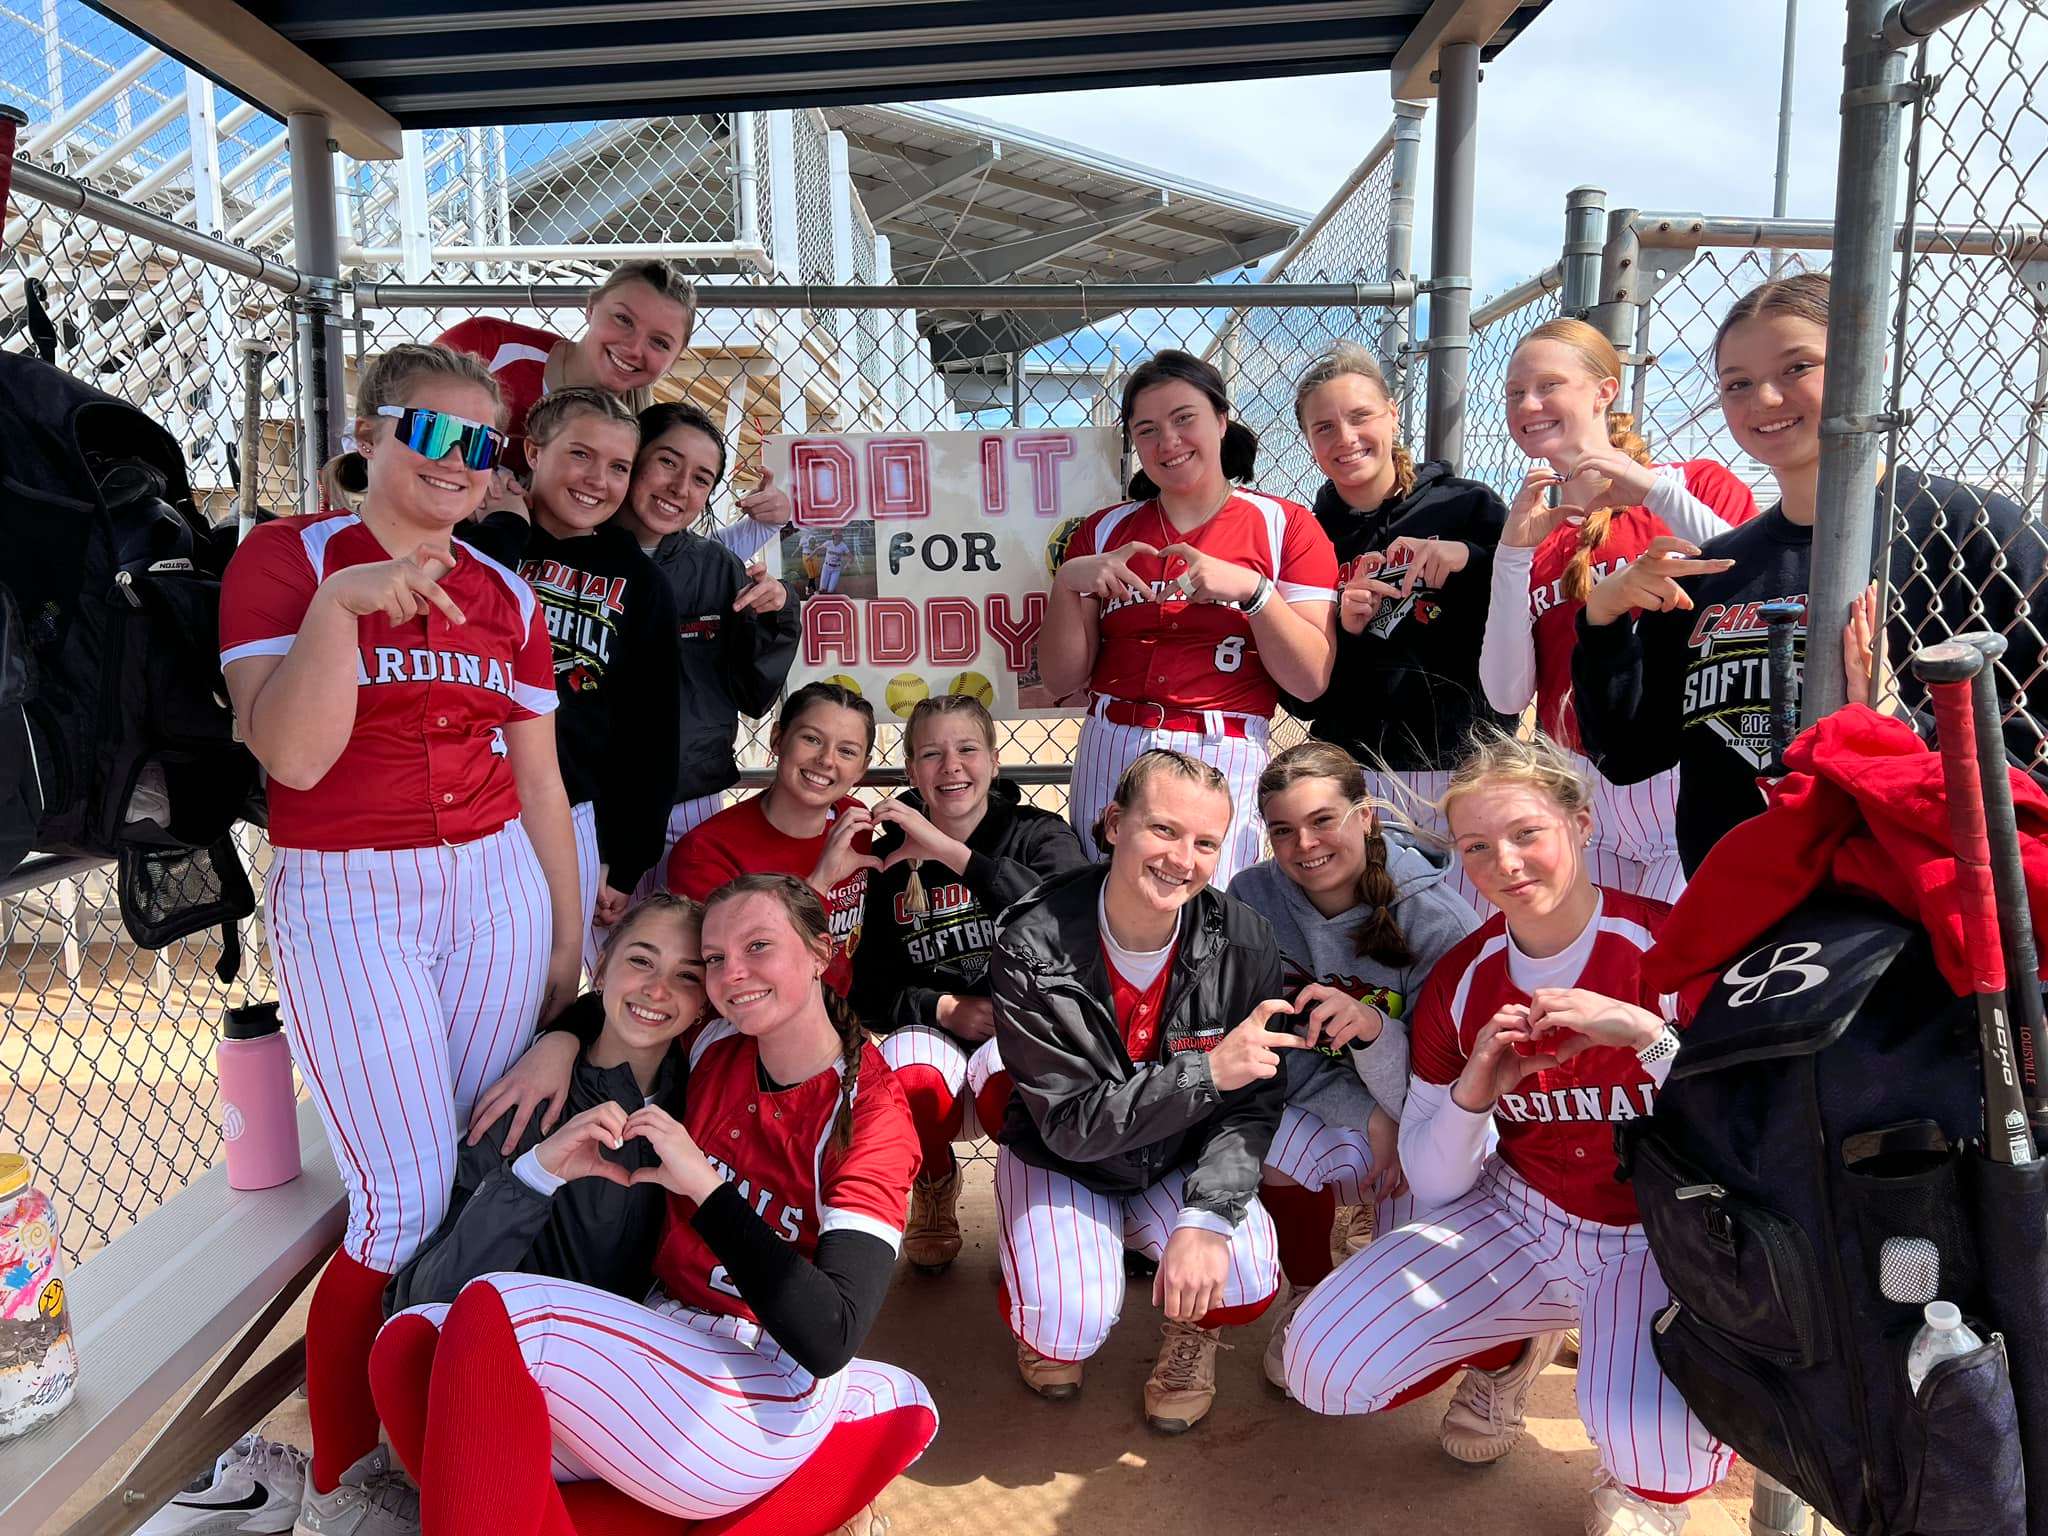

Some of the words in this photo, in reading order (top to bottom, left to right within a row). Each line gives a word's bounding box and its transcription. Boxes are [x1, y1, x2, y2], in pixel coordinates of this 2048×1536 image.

[790, 439, 932, 526] DO
[981, 434, 1076, 517] IT
[889, 531, 1002, 575] FOR
[803, 591, 1048, 672] ADDY
[1993, 1008, 2014, 1087] ECHO
[2019, 1025, 2037, 1086] LOUISVILLE
